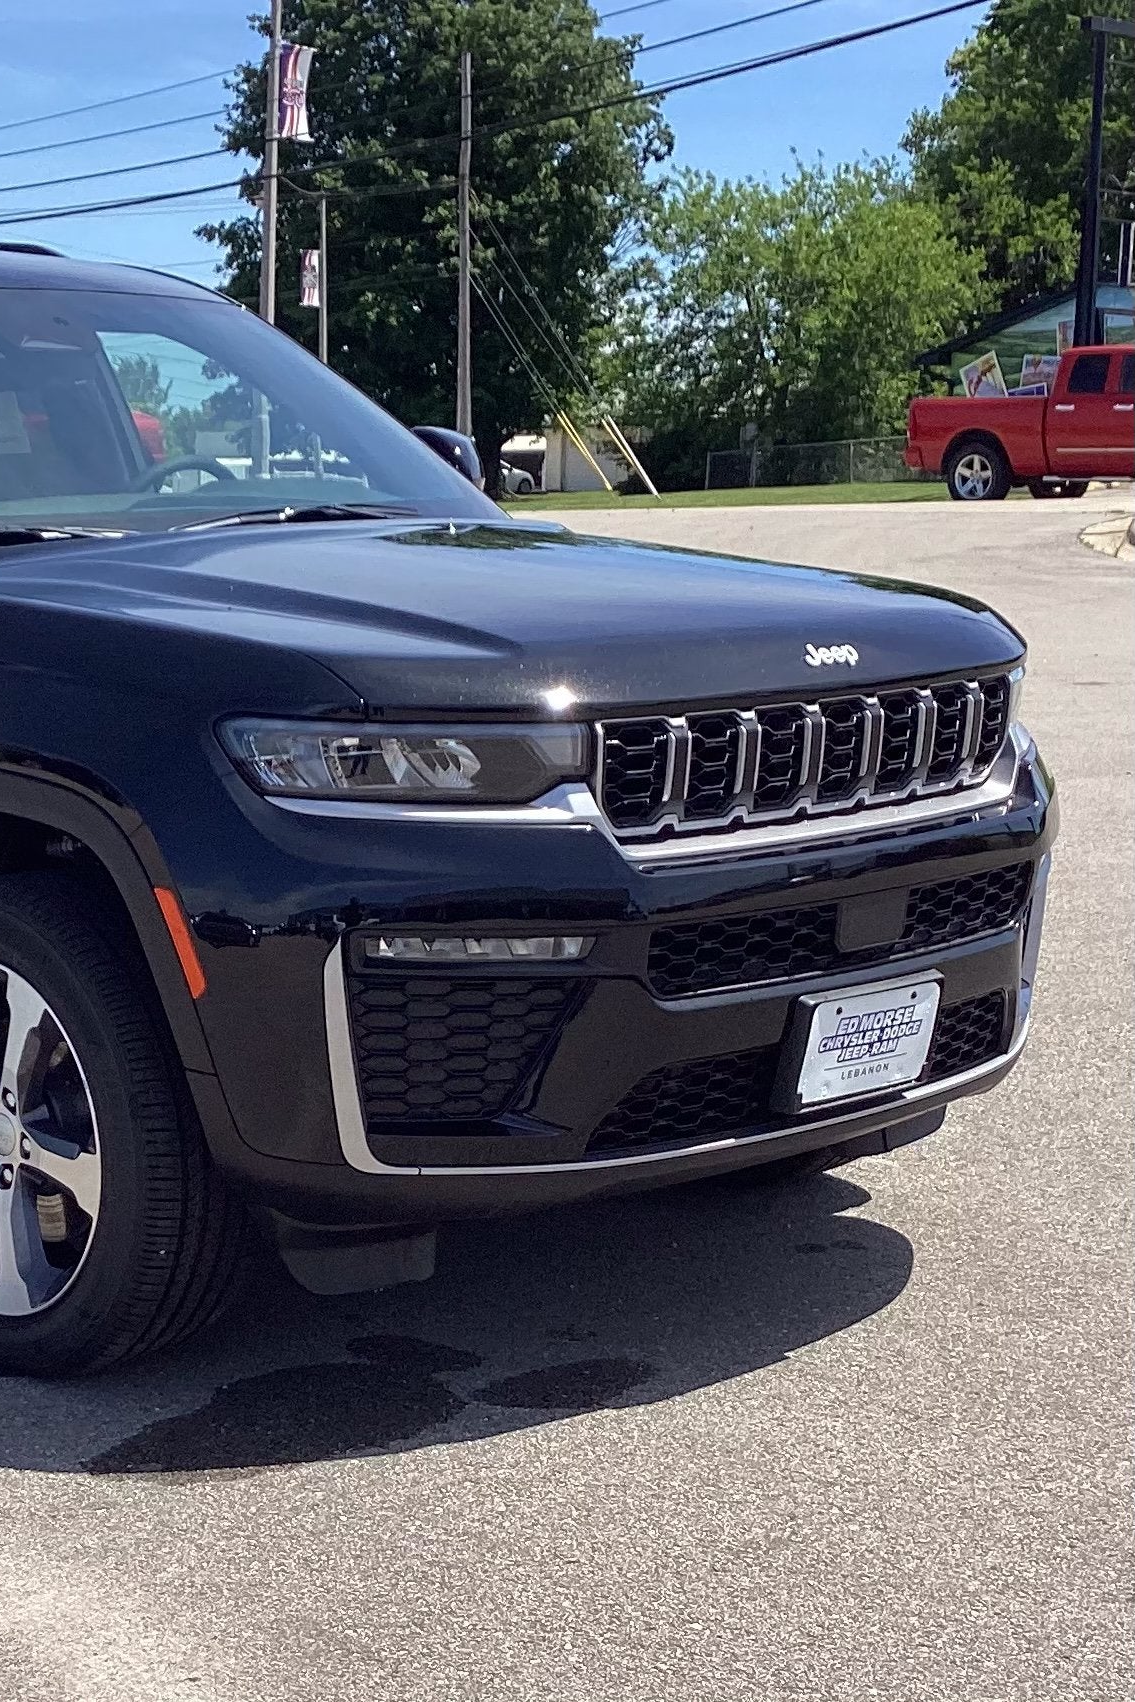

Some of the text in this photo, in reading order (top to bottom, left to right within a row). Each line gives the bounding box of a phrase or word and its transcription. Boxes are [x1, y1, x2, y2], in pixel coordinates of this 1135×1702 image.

[805, 643, 859, 667] Jeep
[836, 1005, 915, 1036] ED MORSE
[841, 1063, 890, 1080] LEBANON
